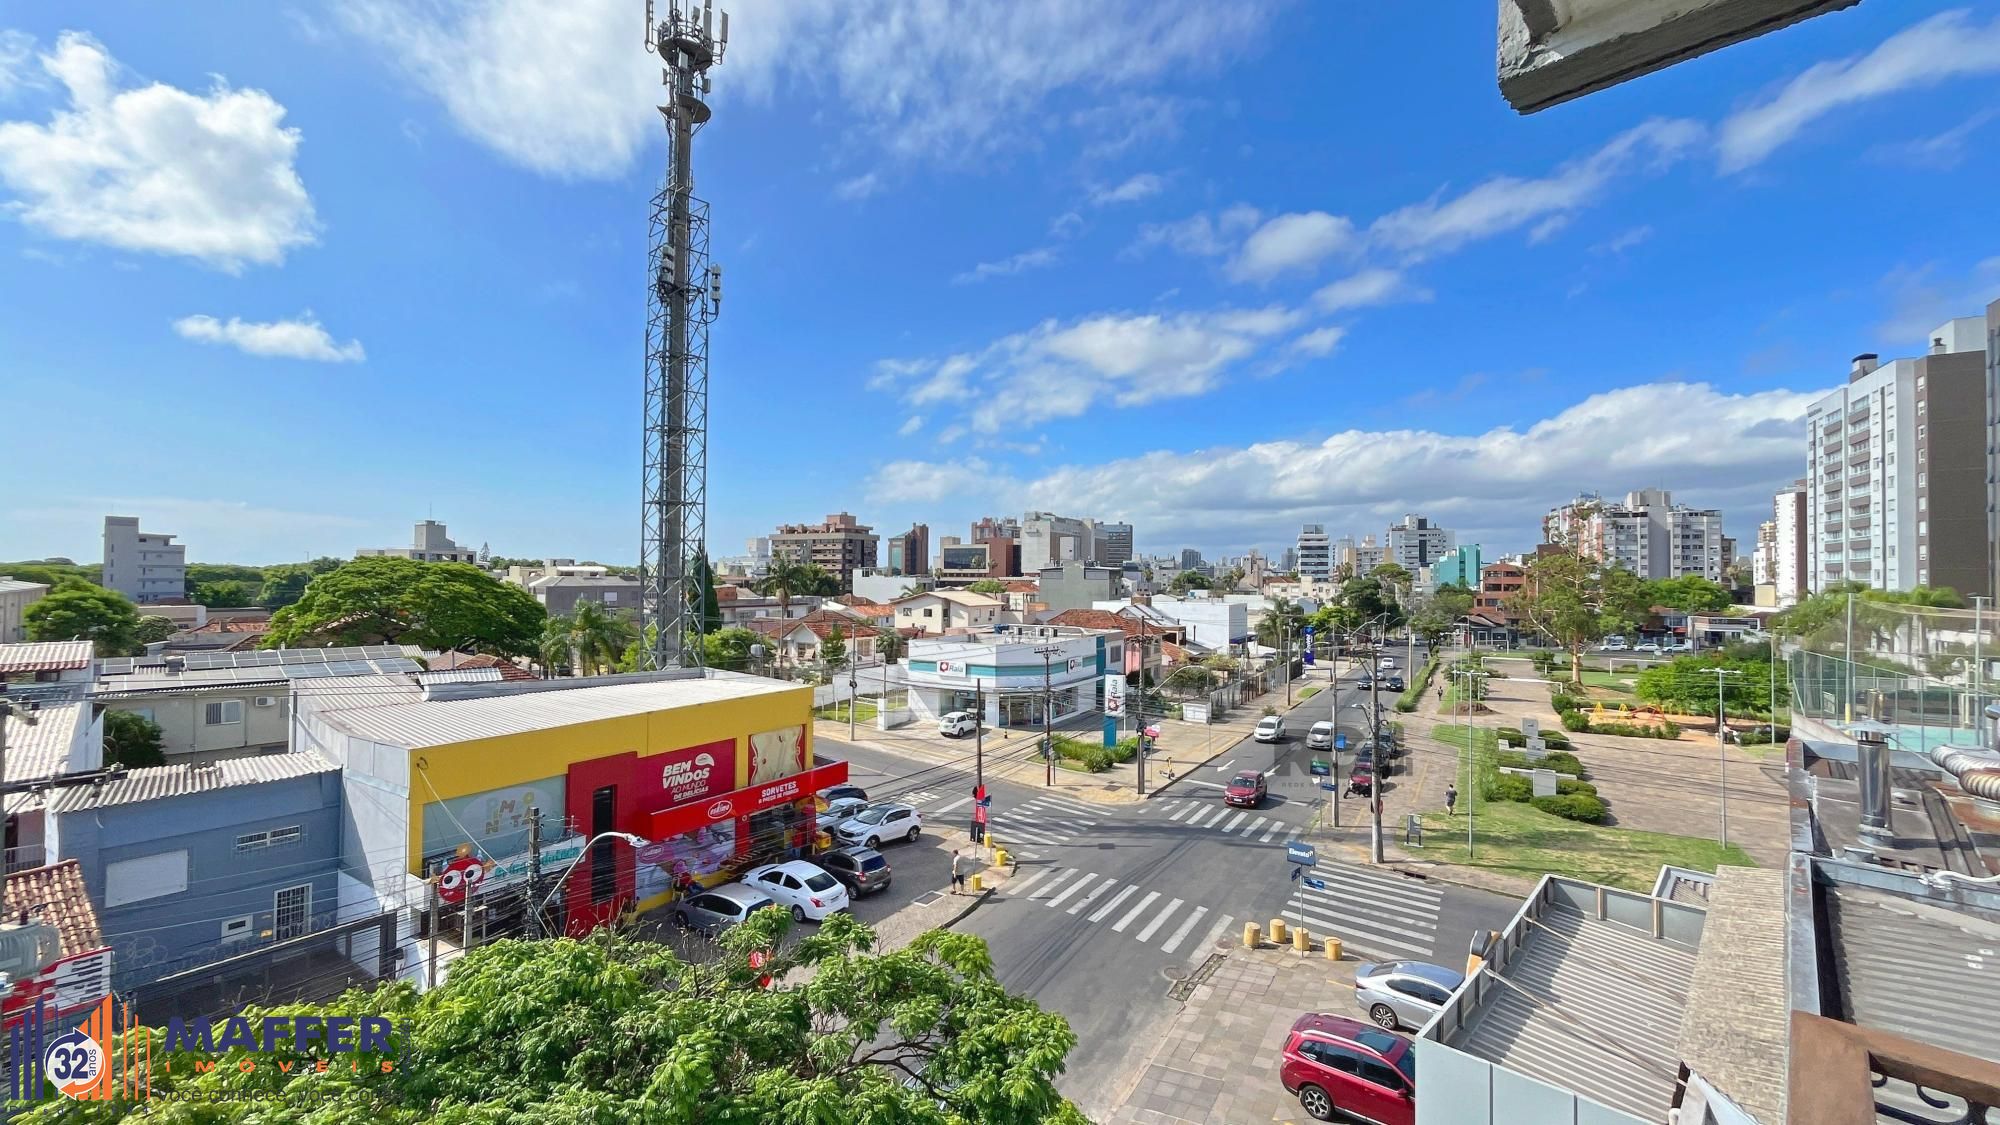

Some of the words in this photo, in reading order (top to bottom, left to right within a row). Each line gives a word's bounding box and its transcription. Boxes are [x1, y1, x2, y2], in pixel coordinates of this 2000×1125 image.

[1110, 679, 1121, 698] Raia
[662, 760, 692, 777] BEM
[662, 767, 710, 789] VINDOS
[671, 785, 681, 794] AO
[682, 780, 706, 792] MUNDO
[761, 781, 797, 798] SORVETES
